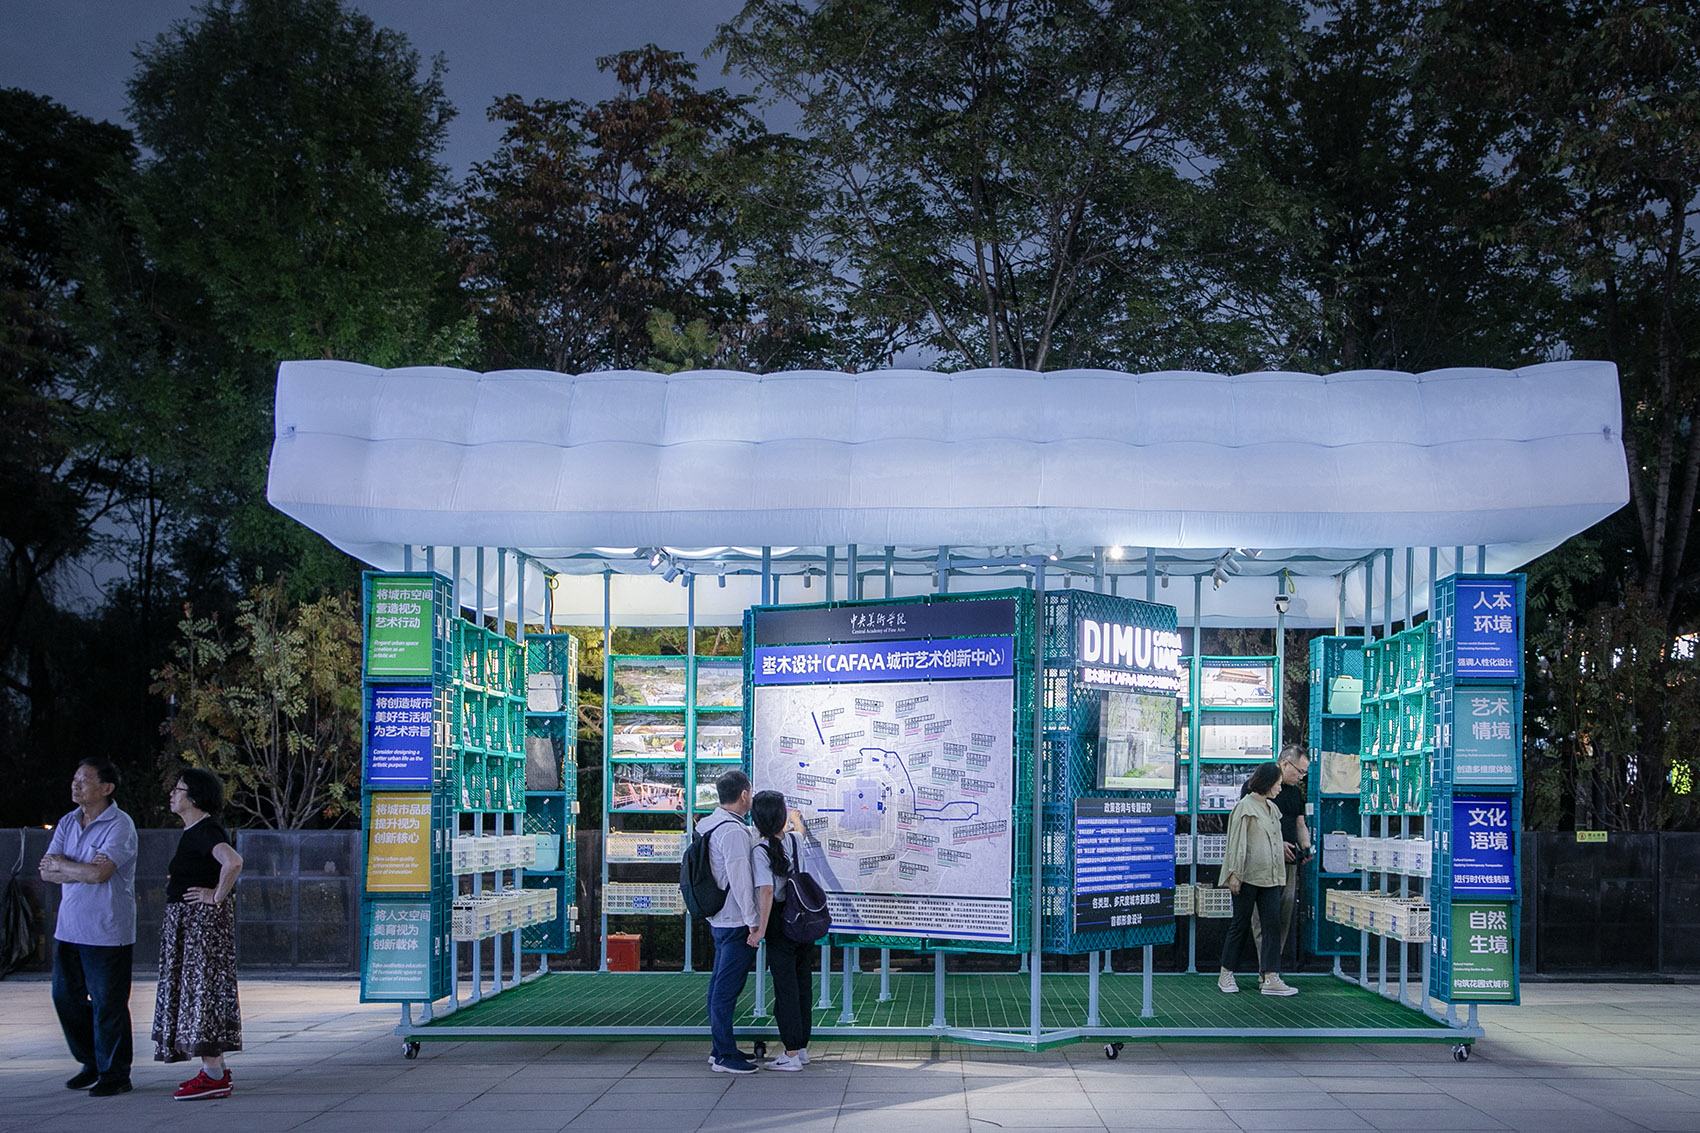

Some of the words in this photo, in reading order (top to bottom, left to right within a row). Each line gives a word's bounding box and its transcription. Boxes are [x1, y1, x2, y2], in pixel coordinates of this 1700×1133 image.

[376, 589, 433, 601] 将城市空间
[1473, 591, 1512, 610] 人本
[376, 603, 421, 614] 营造视为
[375, 616, 420, 628] 艺术行动
[1473, 615, 1513, 634] 环境
[1083, 619, 1152, 669] DIMU
[1457, 658, 1513, 667] 强调人性化设计
[376, 697, 432, 709] 将创造城市
[1471, 697, 1510, 716] 艺术
[375, 711, 432, 723] 美好生活视
[374, 725, 431, 737] 为艺术宗旨
[1472, 721, 1511, 740] 情境
[375, 804, 432, 816] 将城市品质
[1103, 802, 1152, 814] 政策咨询与专题研究
[1468, 807, 1507, 827] 文化
[375, 818, 420, 830] 提升视为
[374, 832, 420, 844] 创新核心
[1469, 831, 1509, 850] 语境
[1453, 874, 1511, 884] 进行时代性转译
[1092, 893, 1161, 909] 各类型、多尺度城市更新实践
[375, 910, 431, 922] 将人文空间
[1110, 913, 1143, 927] 首都形象设计
[1469, 910, 1507, 930] 自然
[374, 924, 419, 936] 美育视为
[373, 938, 419, 950] 创新载体
[1469, 934, 1509, 954] 生境
[1453, 979, 1509, 989] 构筑花园式城市
